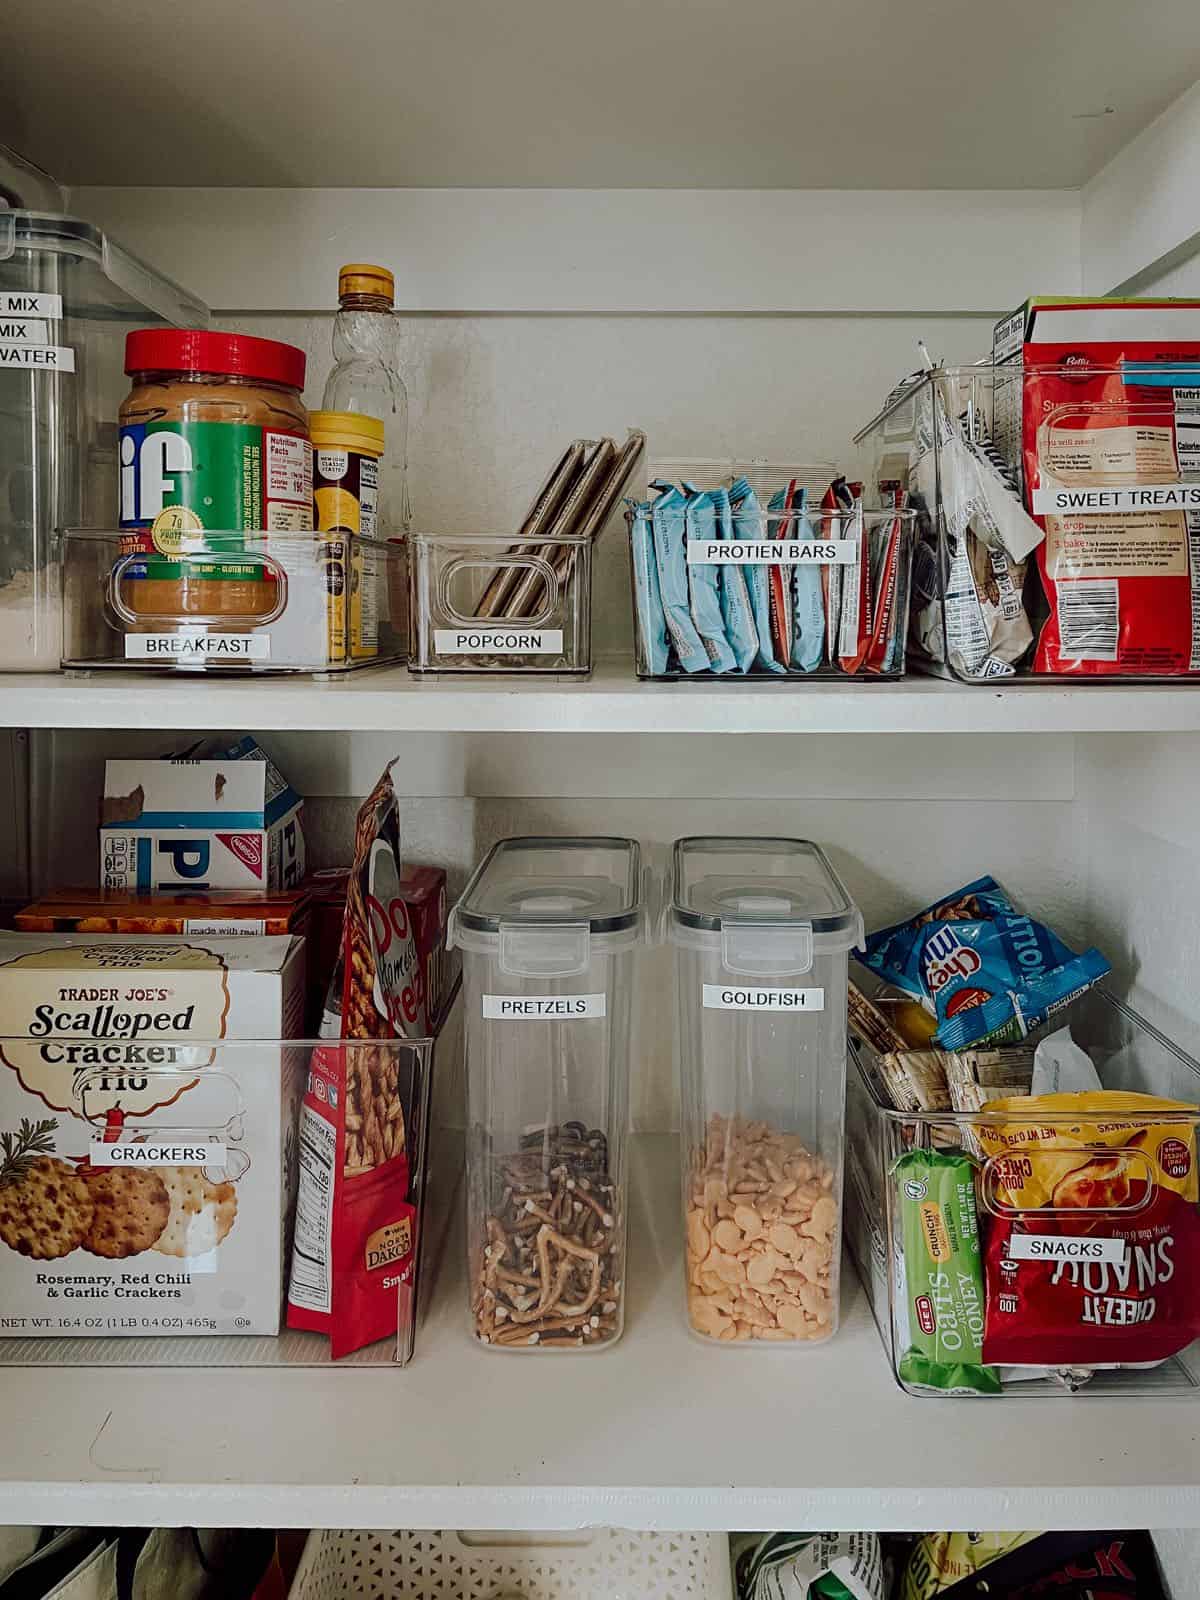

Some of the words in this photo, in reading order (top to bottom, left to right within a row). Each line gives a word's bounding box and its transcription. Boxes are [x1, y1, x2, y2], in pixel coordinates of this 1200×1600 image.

[8, 297, 39, 311] MIX
[0, 324, 27, 338] MIX
[118, 431, 193, 521] if
[1056, 492, 1122, 508] SWEET
[1128, 489, 1200, 505] TREATS
[252, 492, 261, 530] INFORMATIO
[1063, 521, 1085, 531] drop
[707, 545, 783, 559] PROTIEN
[788, 545, 837, 559] BARS
[882, 576, 896, 610] PEANUT
[877, 612, 890, 645] BUTTER
[146, 639, 252, 652] BREAKFAST
[457, 635, 542, 648] POPCORN
[232, 837, 259, 863] NABISCO
[190, 927, 216, 936] made
[219, 927, 238, 936] with
[82, 945, 180, 958] Scalloped
[83, 953, 169, 963] Cracker
[99, 960, 142, 968] Trio
[59, 988, 119, 1001] TRADER
[125, 988, 168, 1001] JOE'S
[721, 991, 806, 1006] GOLDFISH
[501, 1000, 586, 1014] PRETZELS
[29, 1004, 195, 1039] Scalloped
[1026, 1130, 1040, 1141] WT
[1041, 1127, 1057, 1140] NET
[110, 1147, 207, 1161] CRACKERS
[1167, 1158, 1183, 1167] real
[318, 1169, 329, 1186] 130
[923, 1208, 941, 1257] CRUNCHY
[959, 1224, 970, 1240] NET
[1030, 1240, 1104, 1257] SNACKS
[36, 1273, 116, 1287] Rosemary,
[121, 1273, 150, 1285] Red
[155, 1273, 192, 1285] Chili
[46, 1287, 59, 1299] &
[63, 1287, 110, 1299] Garlic
[114, 1287, 182, 1299] Crackers
[956, 1272, 984, 1348] HONEY
[957, 1303, 967, 1324] AND
[1000, 1300, 1017, 1313] 100
[1, 1318, 26, 1328] NET
[31, 1318, 53, 1328] WT.
[58, 1318, 82, 1328] 16.4
[84, 1318, 103, 1328] OZ
[107, 1318, 117, 1330] (1
[119, 1318, 138, 1328] LB
[141, 1318, 159, 1328] 0.4
[161, 1318, 184, 1330] OZ)
[185, 1318, 217, 1330] 465g
